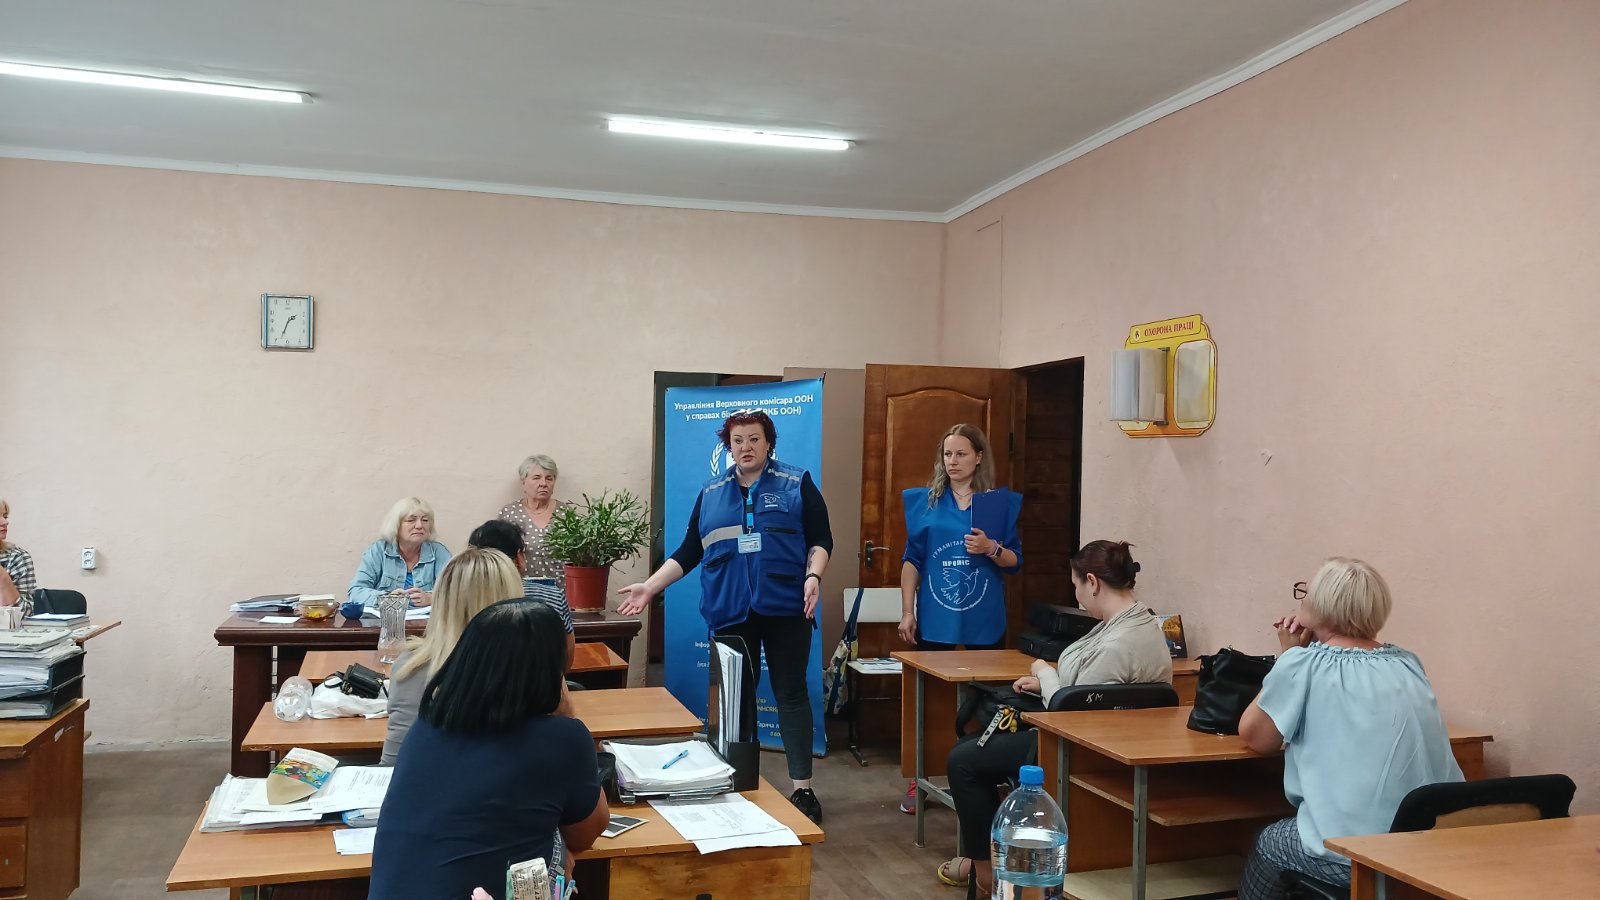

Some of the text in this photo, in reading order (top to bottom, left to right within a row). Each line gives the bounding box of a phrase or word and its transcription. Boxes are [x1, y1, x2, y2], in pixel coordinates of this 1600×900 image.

[1144, 321, 1194, 337] ОХОРОНА ПРАЦІ
[674, 394, 814, 411] Управління Верховного комісара ООН
[691, 411, 720, 421] справах
[780, 405, 802, 416] ООН)
[932, 540, 964, 559] ГУМАНІТАР
